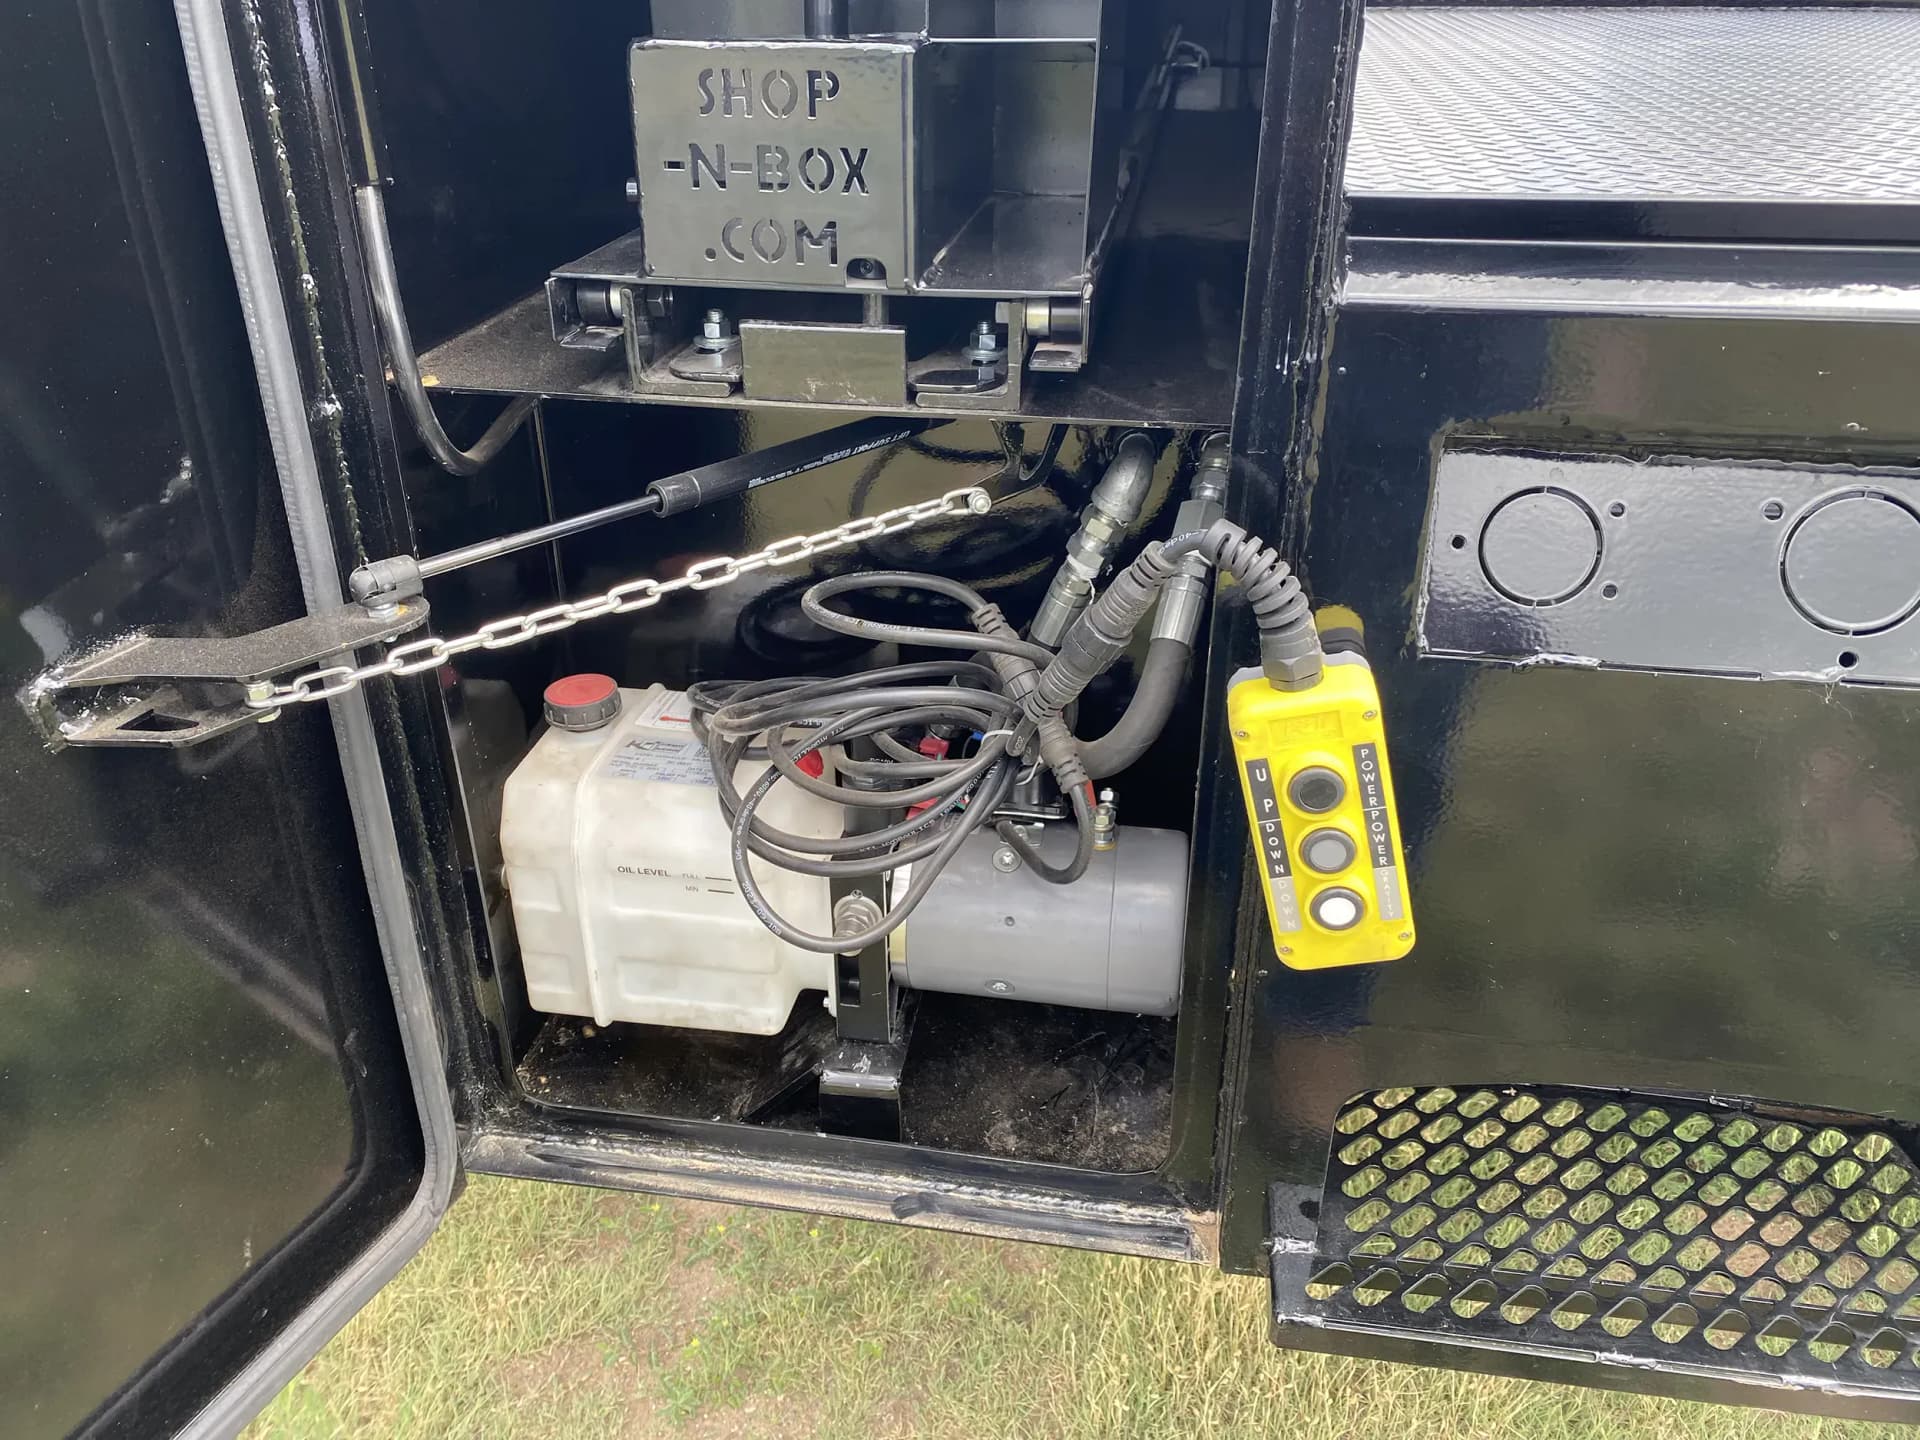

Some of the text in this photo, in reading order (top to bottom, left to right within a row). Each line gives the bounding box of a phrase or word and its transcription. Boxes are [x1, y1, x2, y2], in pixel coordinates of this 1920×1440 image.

[698, 68, 840, 120] SHOP
[664, 143, 870, 196] -N-BOX
[704, 217, 838, 267] .COM
[852, 430, 911, 455] LIFT SUPPORT
[1256, 767, 1274, 813] UP
[1361, 748, 1378, 807] POWER
[1265, 822, 1285, 874] DOWN
[1371, 810, 1388, 866] POWER
[617, 865, 671, 877] OIL LEVEL
[1279, 881, 1297, 930] DOWN
